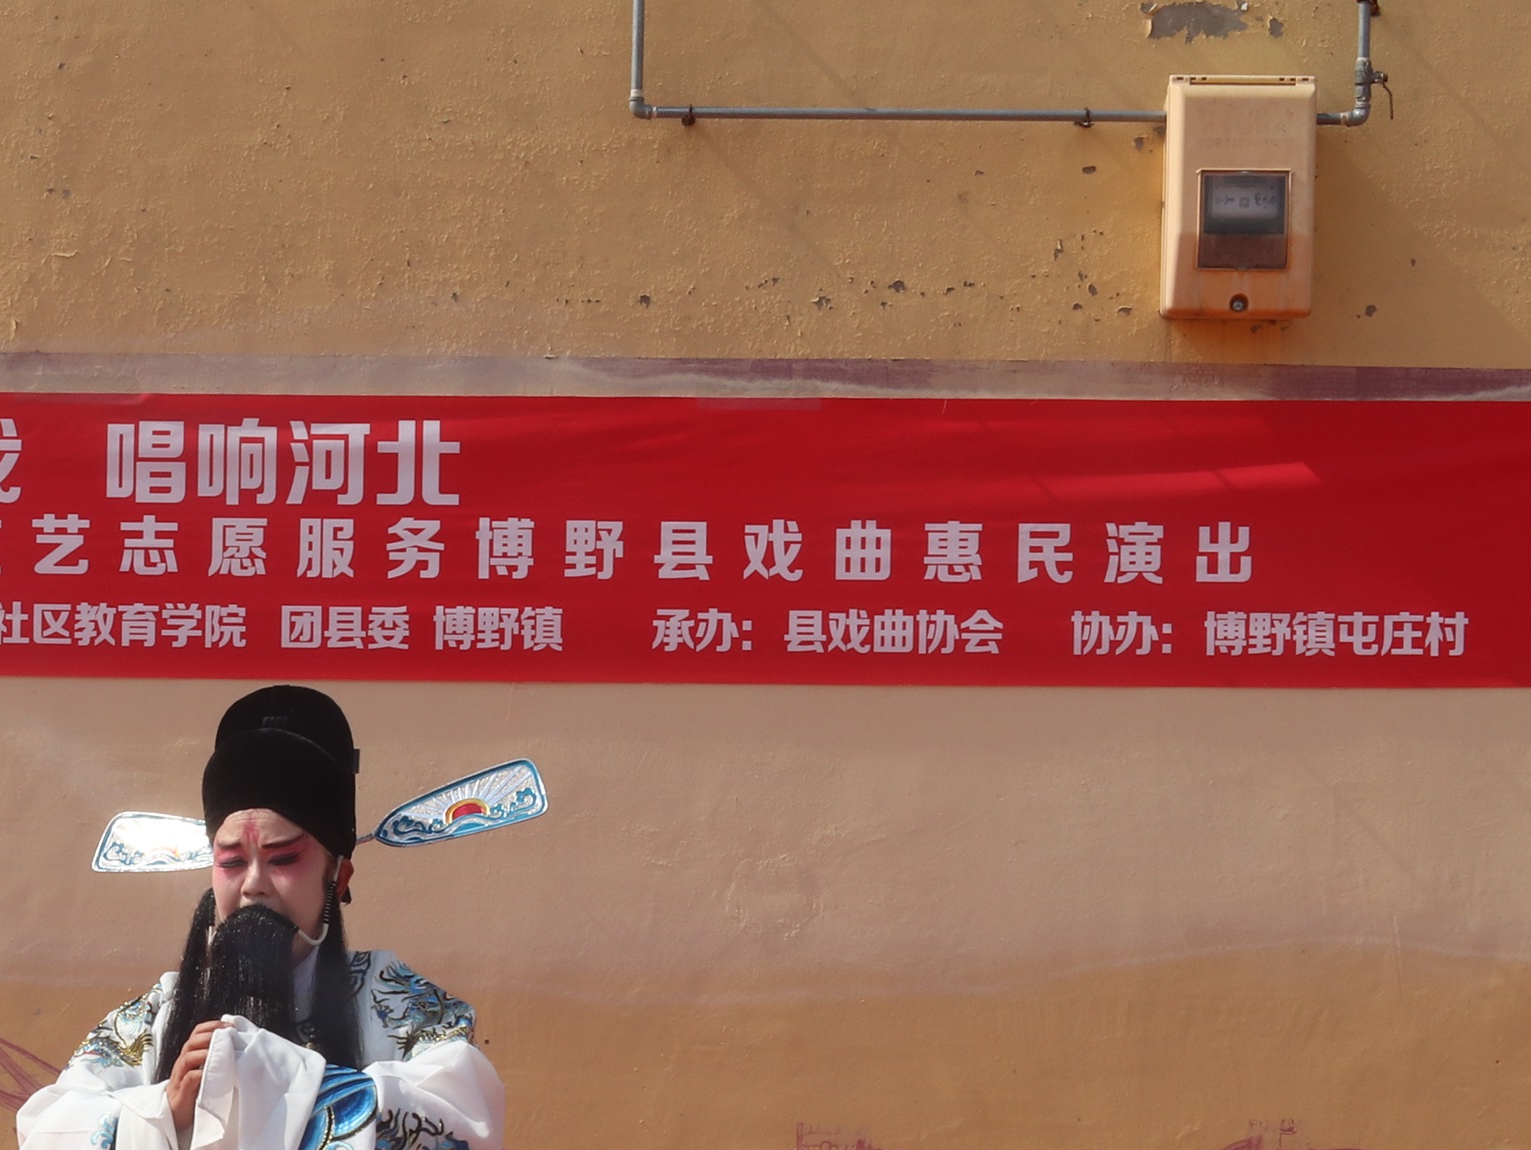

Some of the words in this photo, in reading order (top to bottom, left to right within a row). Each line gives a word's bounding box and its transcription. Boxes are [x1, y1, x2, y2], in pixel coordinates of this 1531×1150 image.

[107, 418, 460, 505] 唱响河北
[281, 606, 409, 649] 团县委
[434, 606, 562, 651] 博野镇
